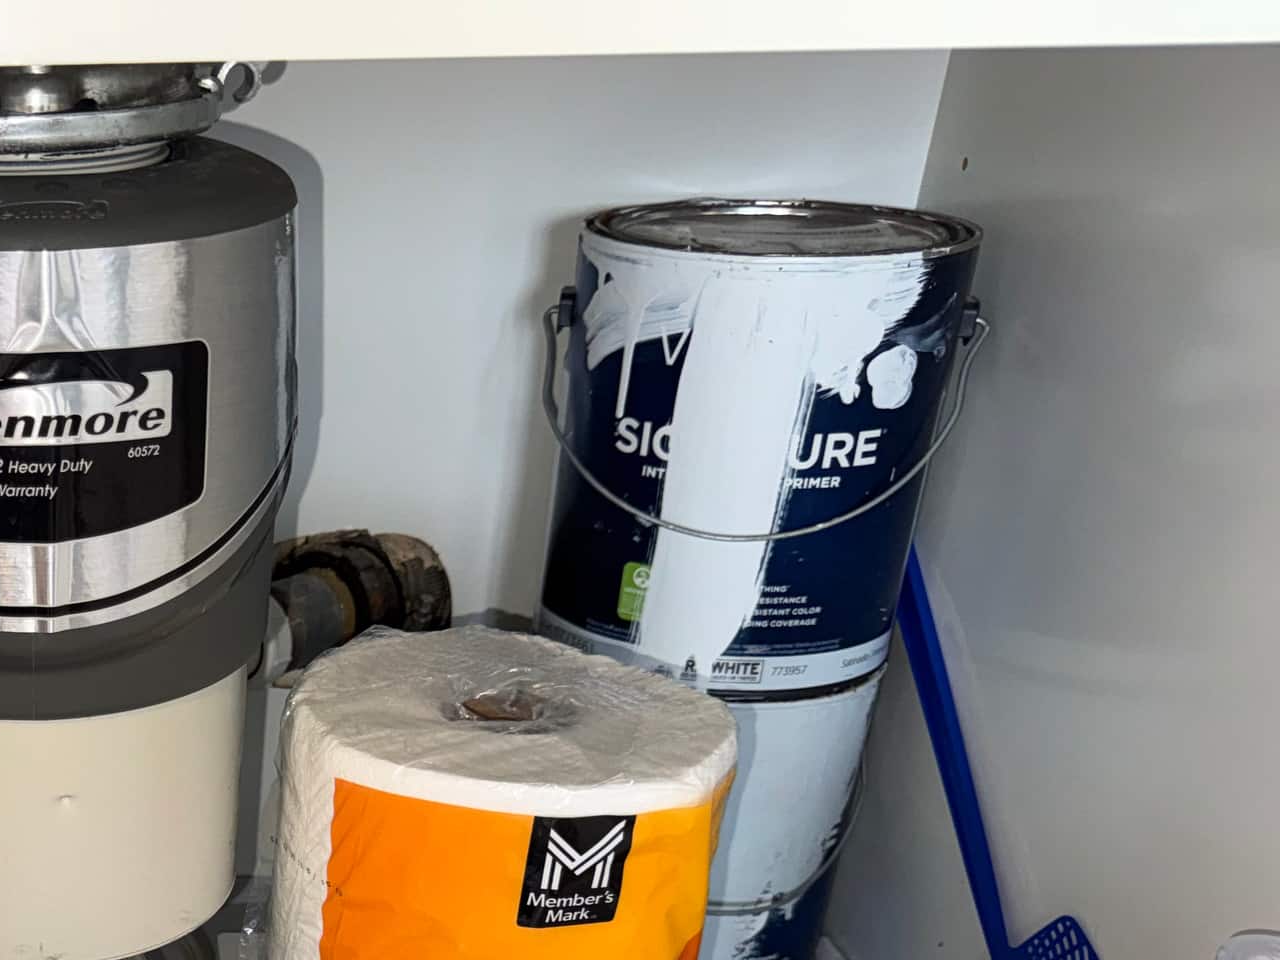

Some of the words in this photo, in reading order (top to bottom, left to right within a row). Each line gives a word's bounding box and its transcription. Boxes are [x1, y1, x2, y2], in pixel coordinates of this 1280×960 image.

[127, 444, 161, 458] 60572
[8, 459, 57, 475] Heavy
[60, 458, 93, 475] Duty
[782, 476, 841, 489] PRIMER
[758, 596, 807, 605] ESISTANCE
[792, 606, 822, 616] COLOR
[770, 617, 817, 628] COVERAGE
[711, 662, 760, 676] WHITE
[526, 890, 614, 909] Member's
[545, 907, 590, 923] Mark
